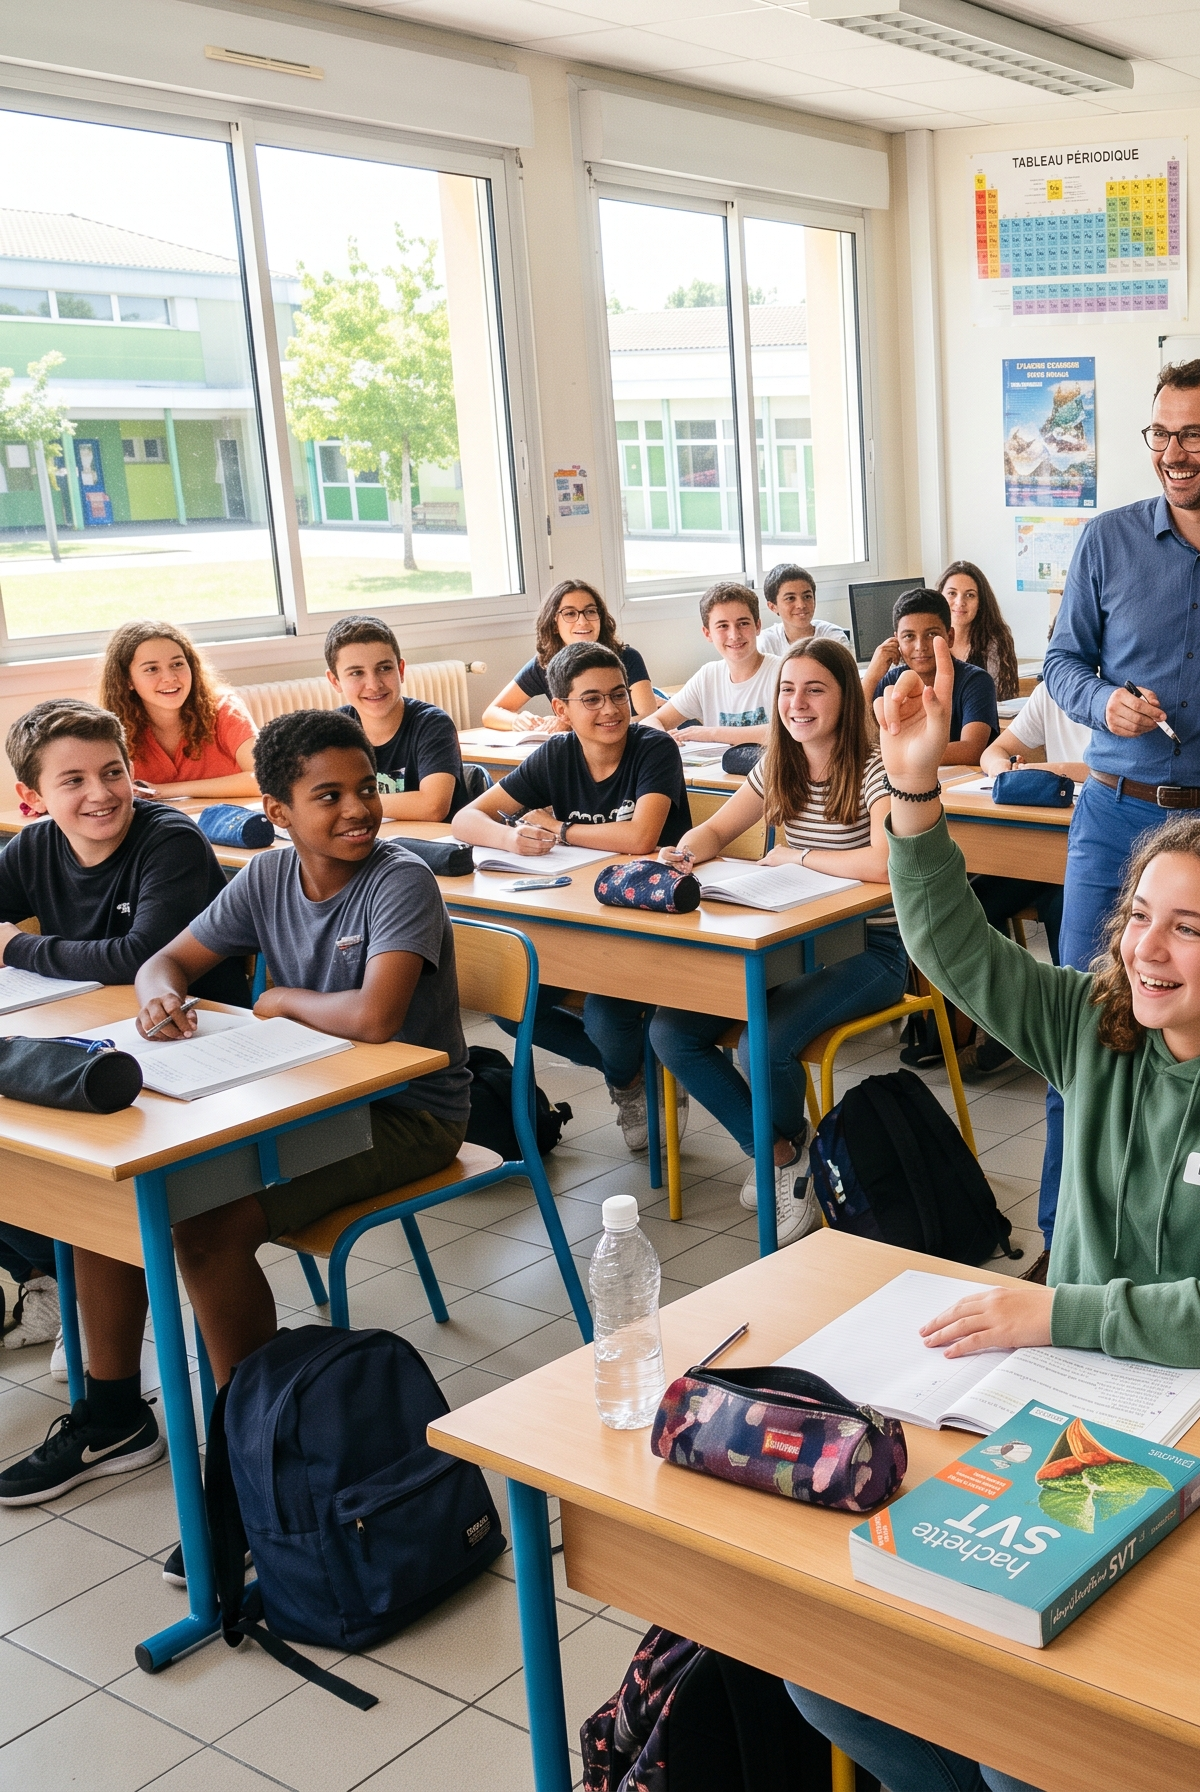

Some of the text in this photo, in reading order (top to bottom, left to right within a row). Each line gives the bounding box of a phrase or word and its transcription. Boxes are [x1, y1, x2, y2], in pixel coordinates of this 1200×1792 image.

[1012, 148, 1140, 168] TABLEAU PÉRIODIQUE
[911, 1522, 1031, 1580] hachette
[943, 1503, 1062, 1555] SVT
[1108, 1537, 1137, 1580] SVT
